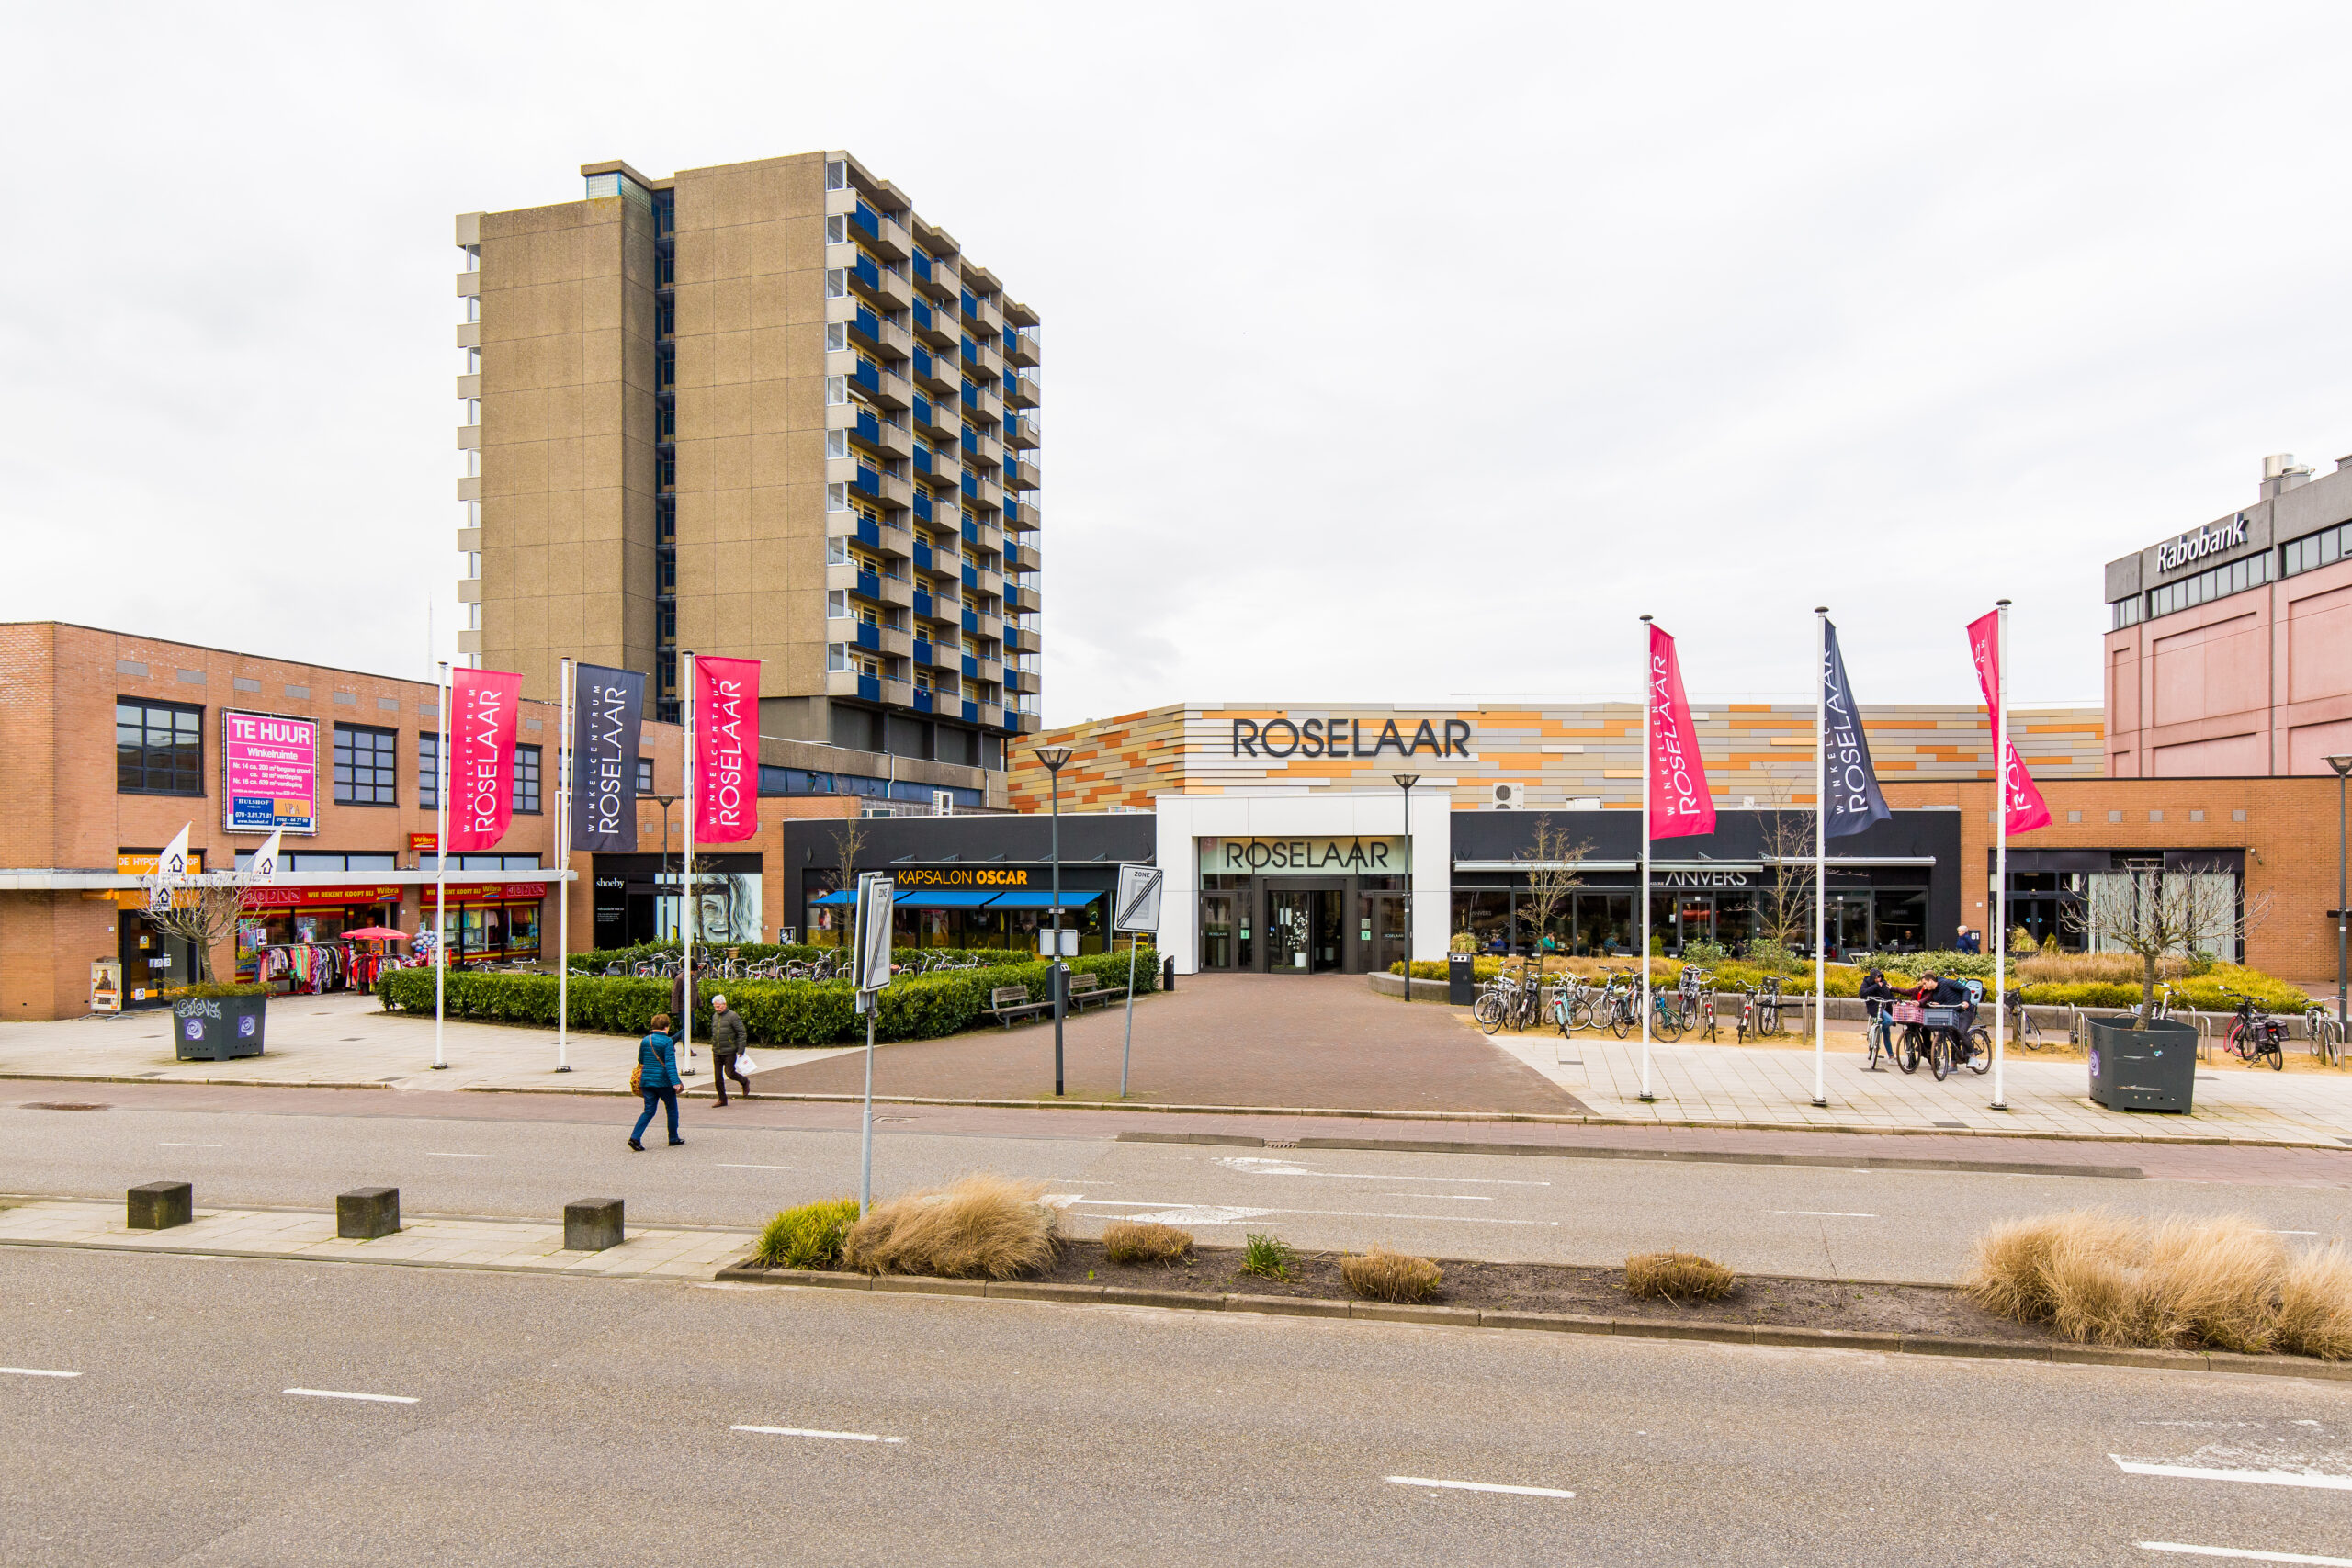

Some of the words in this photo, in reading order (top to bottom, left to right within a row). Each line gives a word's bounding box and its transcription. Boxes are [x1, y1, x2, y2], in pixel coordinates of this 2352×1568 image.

[2156, 512, 2248, 573] Rabobank
[232, 718, 256, 739] TE
[260, 722, 311, 745] HUUR
[1233, 718, 1471, 758] ROSELAAR
[1653, 655, 1700, 815] ROSELAAR
[247, 747, 299, 761] Winkelruimte
[463, 689, 476, 832] WINKELCENTRUM
[474, 690, 502, 832] ROSELAAR
[588, 685, 601, 832] WINKELCENTRUM
[598, 687, 627, 834] ROSELAAR
[709, 678, 719, 825] WINKELCENTRUM
[719, 680, 741, 826] ROSELAAR
[413, 834, 436, 843] Wibra
[1226, 841, 1389, 869] ROSELAAR
[118, 857, 130, 866] DE
[898, 870, 972, 885] KAPSALON
[976, 870, 1028, 885] OSCAR
[1665, 871, 1747, 886] ANVERS
[376, 886, 400, 895] Wibra
[596, 877, 625, 889] shoeby
